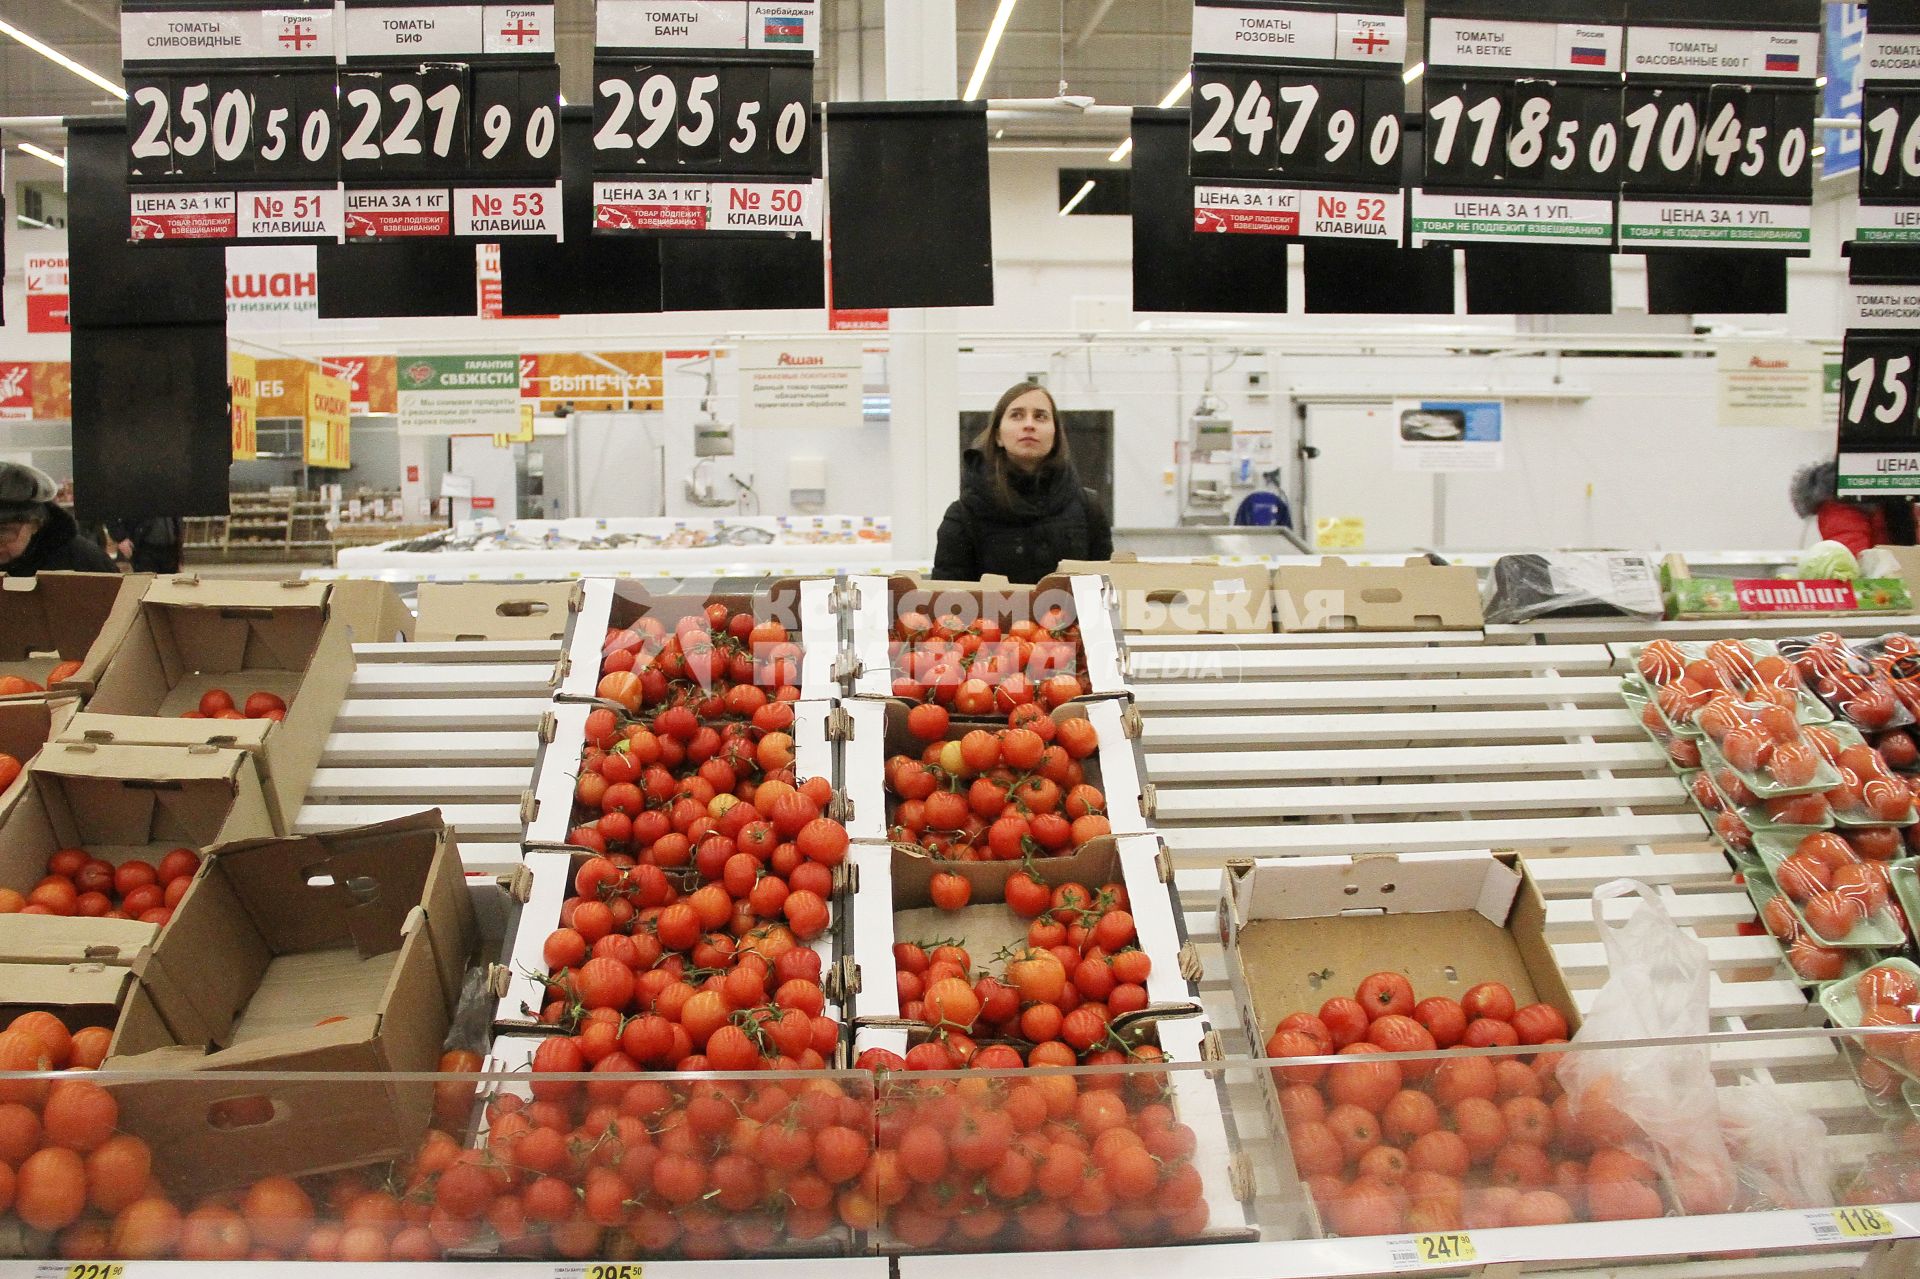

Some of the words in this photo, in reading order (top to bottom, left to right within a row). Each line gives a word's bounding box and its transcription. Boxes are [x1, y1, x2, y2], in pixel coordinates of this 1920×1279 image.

[506, 9, 535, 19] Грузия
[645, 12, 699, 23] ТОМАТЫ
[756, 7, 814, 17] Азербайджан
[283, 15, 312, 24] Грузия
[382, 19, 435, 31] ТОМАТЫ
[1240, 18, 1292, 30] ТОМАТЫ
[1357, 18, 1386, 28] Грузия
[167, 22, 220, 33] ТОМАТЫ
[654, 26, 689, 37] БАНЧ
[1576, 29, 1605, 39] Россия
[147, 35, 242, 48] СЛИВОВИДНЫЕ
[395, 33, 423, 44] БИФ
[1235, 31, 1296, 44] РОЗОВЫЕ
[1455, 31, 1505, 43] ТОМАТЫ
[1770, 36, 1798, 46] Россия
[1457, 45, 1473, 55] НА
[1476, 45, 1512, 57] ВЕТКЕ
[1668, 42, 1718, 53] ТОМАТЫ
[1636, 54, 1718, 67] ФАСОВАННЫЕ
[1721, 57, 1740, 68] 600
[1870, 59, 1920, 69] ФАСОВА
[593, 74, 719, 151] 295
[729, 101, 806, 154] 50
[131, 84, 251, 161] 250
[261, 107, 330, 162] 50
[341, 84, 461, 160] 221
[482, 104, 555, 160] 90
[1192, 80, 1320, 156] 247
[1325, 109, 1400, 165] 90
[1429, 95, 1551, 168] 118
[1551, 120, 1617, 173] 50
[1626, 102, 1741, 176] 104
[1740, 126, 1806, 177] 50
[603, 188, 644, 202] ЦЕНА
[648, 188, 668, 200] ЗА
[672, 189, 678, 200] 1
[684, 189, 702, 201] КГ
[730, 187, 760, 210] №
[771, 189, 802, 212] 50
[1200, 192, 1240, 206] ЦЕНА
[1243, 194, 1263, 206] ЗА
[1267, 195, 1274, 206] 1
[1278, 195, 1295, 207] КГ
[136, 199, 176, 212] ЦЕНА
[179, 198, 200, 211] ЗА
[203, 198, 209, 210] 1
[215, 197, 231, 209] КГ
[254, 196, 283, 219] №
[293, 195, 322, 218] 51
[348, 196, 388, 209] ЦЕНА
[392, 196, 411, 207] ЗА
[415, 195, 422, 207] 1
[428, 195, 444, 207] КГ
[472, 194, 502, 217] №
[512, 192, 544, 217] 53
[1317, 196, 1347, 219] №
[1356, 198, 1386, 221] 52
[635, 210, 659, 218] ТОВАР
[660, 210, 701, 218] ПОДЛЕЖИТ
[1455, 202, 1501, 219] ЦЕНА
[1506, 204, 1528, 217] ЗА
[1534, 205, 1541, 218] 1
[1548, 205, 1573, 219] УП.
[1661, 208, 1706, 224] ЦЕНА
[1710, 210, 1731, 222] ЗА
[1736, 210, 1742, 223] 1
[1749, 210, 1774, 224] УП.
[168, 219, 191, 227] ТОВАР
[192, 218, 231, 227] ПОДЛЕЖИТ
[379, 217, 403, 225] ТОВАР
[404, 216, 444, 224] ПОДЛЕЖИТ
[471, 219, 546, 232] КЛАВИША
[638, 217, 697, 226] ВЗВЕШИВАНИЮ
[727, 213, 804, 226] КЛАВИША
[1255, 215, 1294, 224] ПОДЛЕЖИТ
[171, 226, 228, 235] ВЗВЕШИВАНИЮ
[252, 220, 326, 233] КЛАВИША
[383, 224, 441, 232] ВЗВЕШИВАНИЮ
[1233, 222, 1290, 231] ВЗВЕШИВАНИЮ
[1315, 221, 1387, 235] КЛАВИША
[1422, 221, 1454, 231] ТОВАР
[1457, 222, 1470, 231] НЕ
[1472, 222, 1525, 234] ПОДЛЕЖИТ
[1528, 224, 1604, 236] ВЗВЕШИВАНИЮ
[1630, 227, 1661, 236] ТОВАР
[1663, 228, 1675, 236] НЕ
[1677, 229, 1729, 238] ПОДЛЕЖИТ
[1730, 230, 1802, 240] ВЗВЕШИВАНИЮ
[29, 258, 70, 269] ПРОВ
[226, 271, 316, 298] шан
[1856, 295, 1901, 305] ТОМАТЫ
[1903, 296, 1920, 305] КО
[464, 360, 514, 369] ГАРАНТИЯ
[777, 352, 824, 366] Ашан
[440, 372, 514, 386] СВЕЖЕСТИ
[550, 374, 650, 392] ВЫПЕЧКА
[255, 380, 284, 398] ЕБ
[1876, 458, 1919, 474] ЦЕНА
[1741, 581, 1849, 606] cumhur
[1840, 1208, 1882, 1232] 118
[1423, 1235, 1459, 1259] 247
[1460, 1235, 1471, 1244] 90
[73, 1264, 112, 1279] 221
[113, 1266, 123, 1276] 90
[591, 1265, 632, 1279] 295
[633, 1266, 643, 1276] 50
